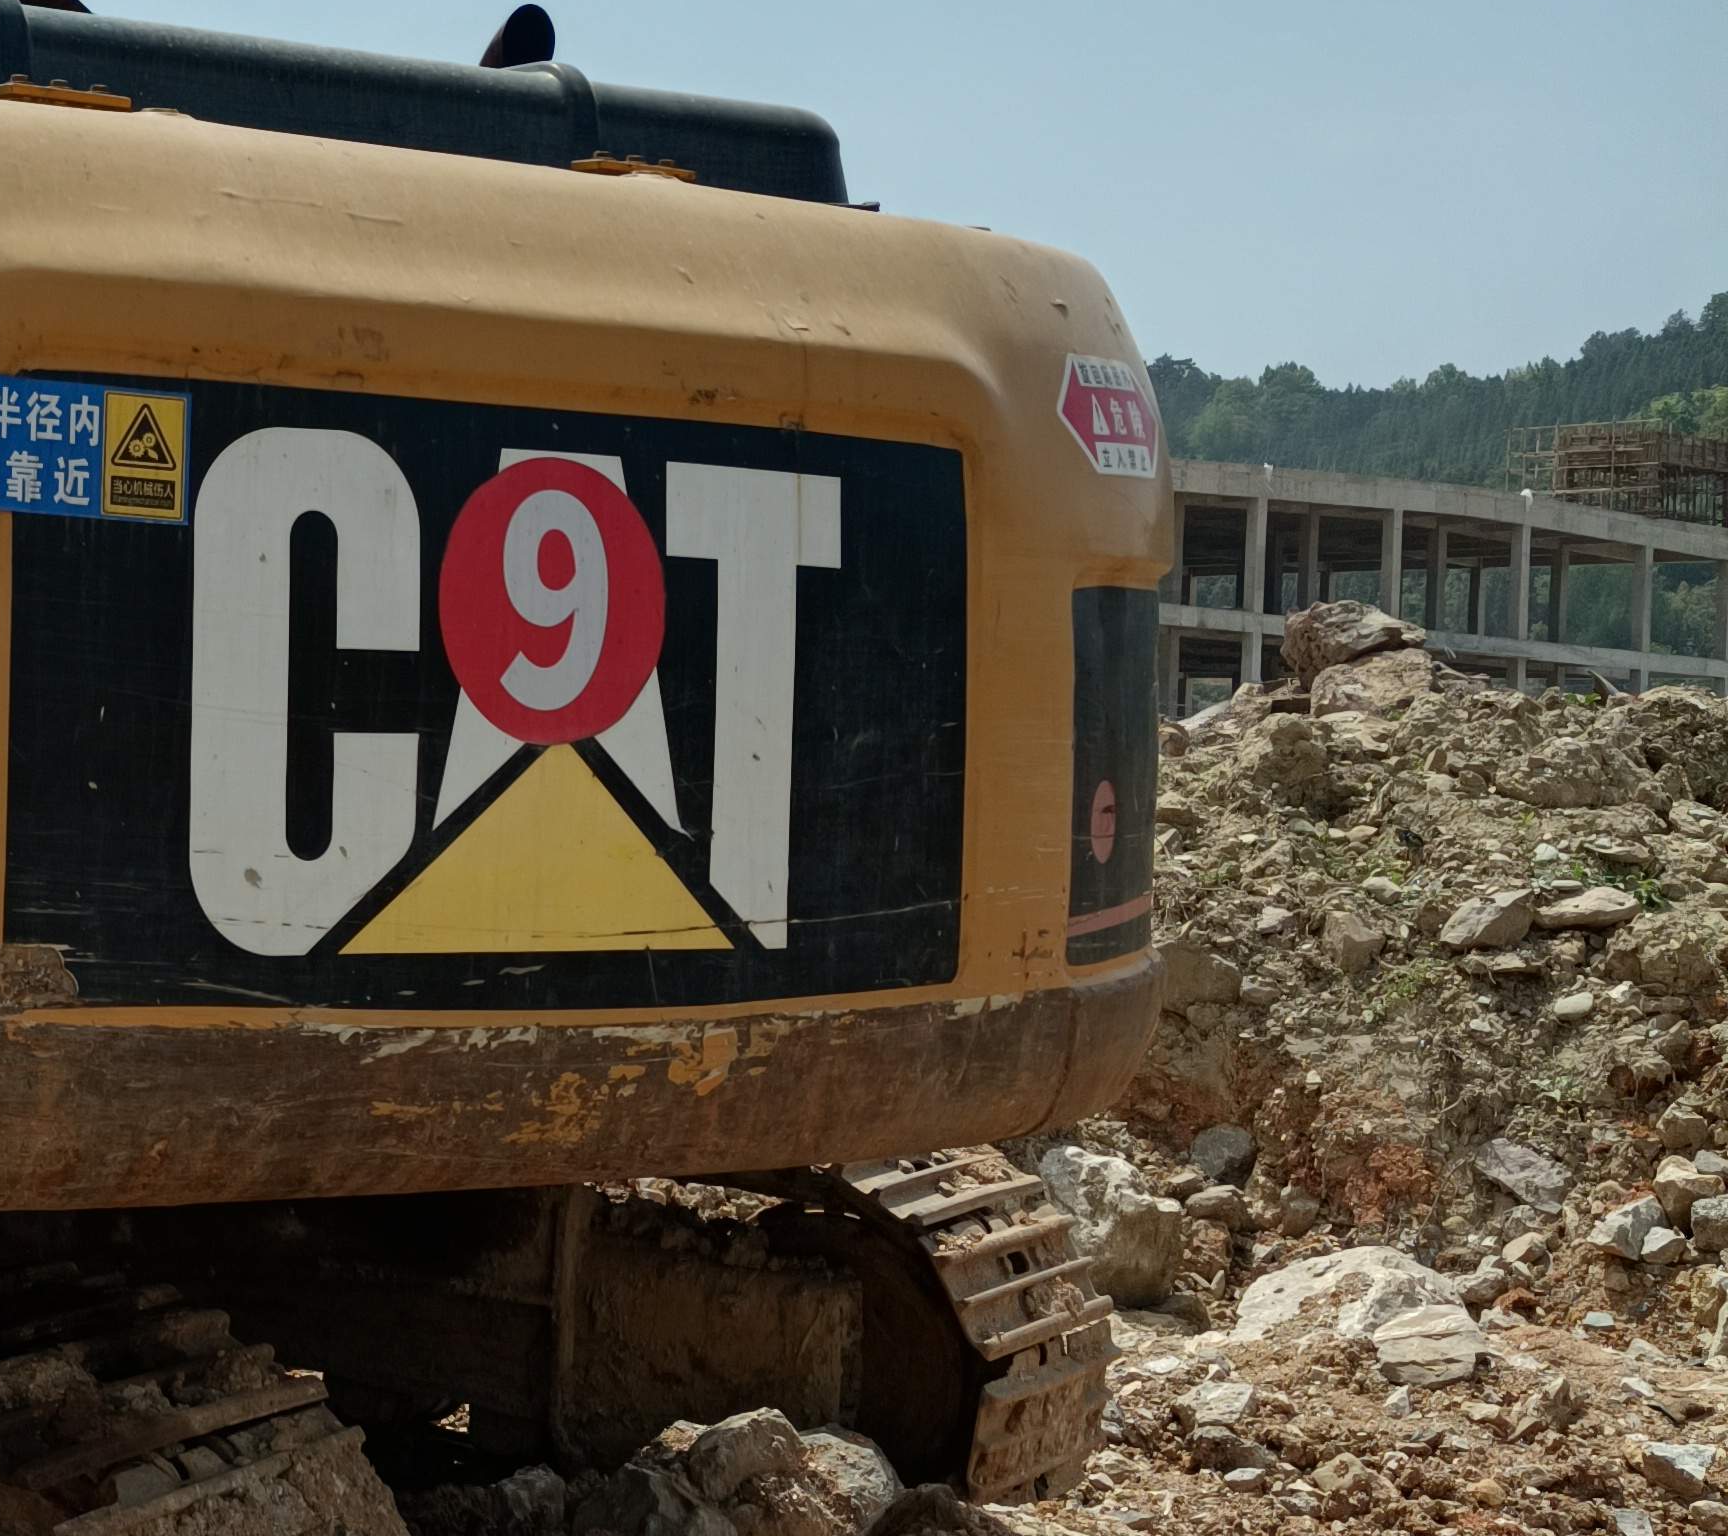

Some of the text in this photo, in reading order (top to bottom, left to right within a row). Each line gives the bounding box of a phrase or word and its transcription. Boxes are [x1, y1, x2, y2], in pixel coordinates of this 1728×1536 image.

[112, 479, 174, 499] 当心机械伤人
[498, 488, 609, 712] 9
